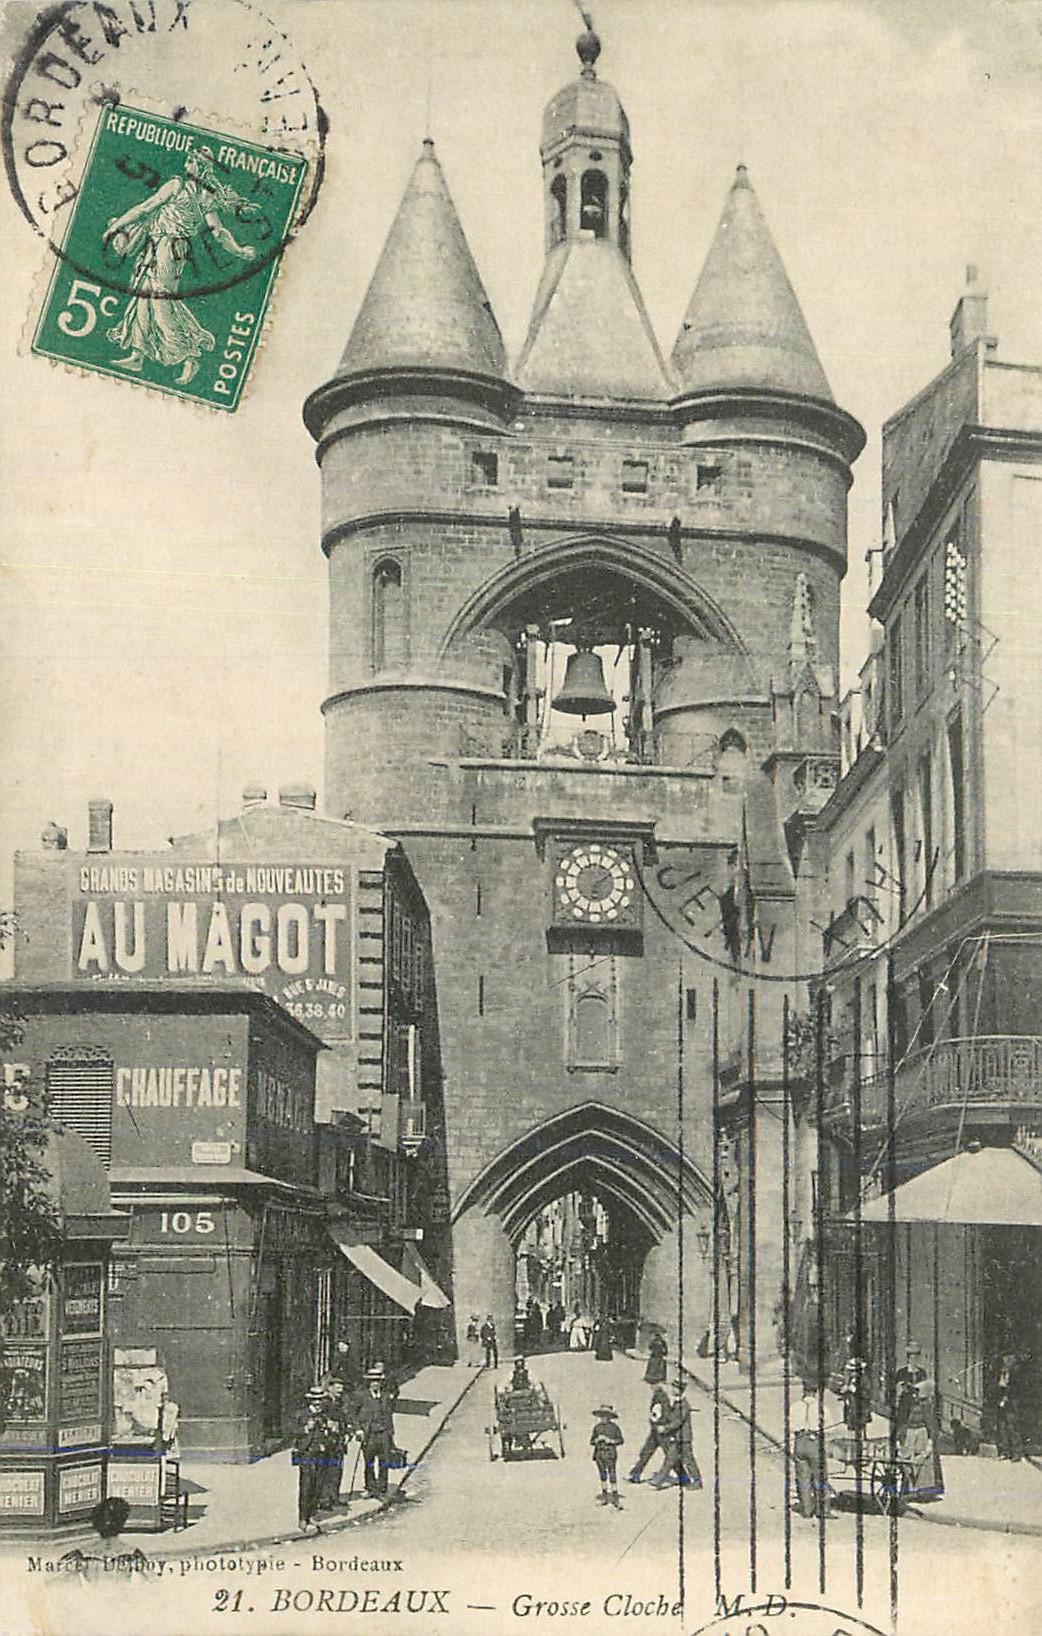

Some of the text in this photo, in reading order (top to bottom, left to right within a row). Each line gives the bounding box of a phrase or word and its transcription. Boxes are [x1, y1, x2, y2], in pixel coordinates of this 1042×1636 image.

[217, 146, 298, 185] FRANÇAISE
[213, 311, 255, 394] POSTES
[80, 867, 138, 892] GRANDS
[143, 867, 223, 893] MAGASINS
[226, 871, 243, 893] de
[78, 901, 346, 975] AU MAGOT
[116, 1067, 242, 1107] CHAUFFAGE
[160, 1212, 216, 1234] 105
